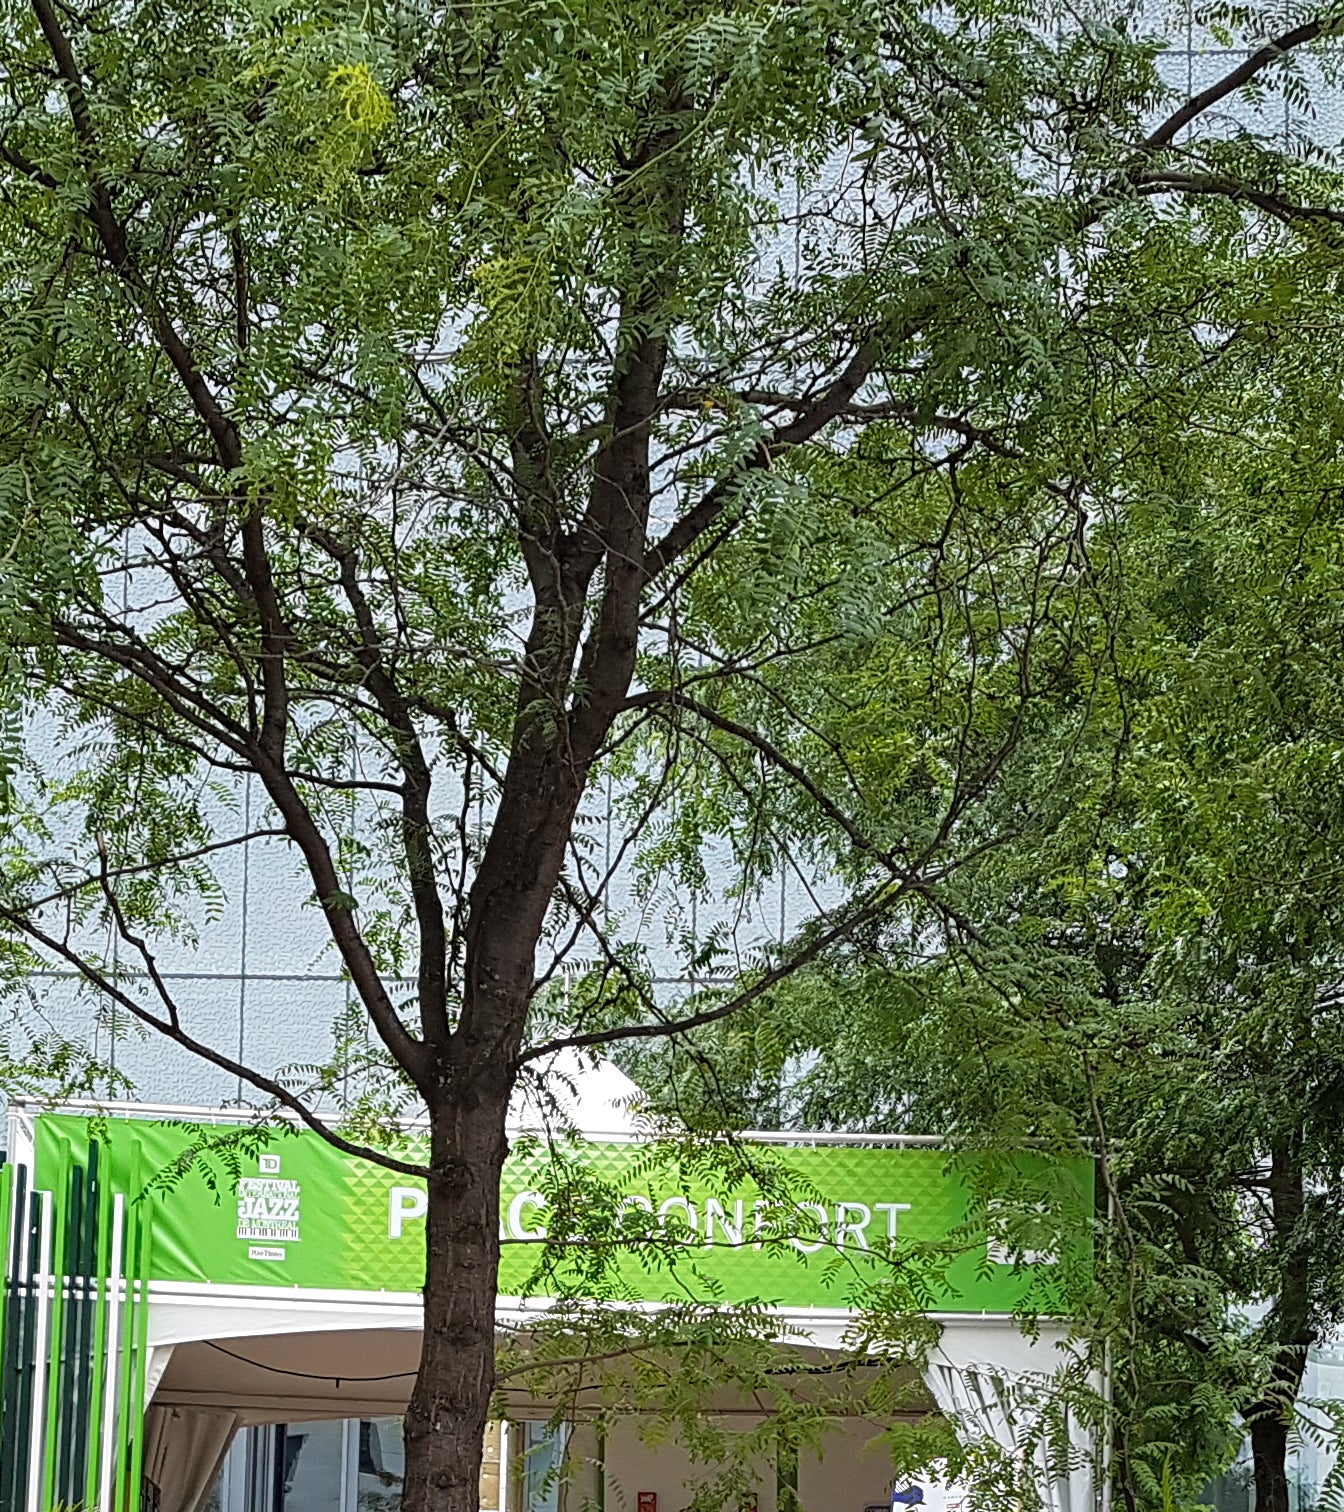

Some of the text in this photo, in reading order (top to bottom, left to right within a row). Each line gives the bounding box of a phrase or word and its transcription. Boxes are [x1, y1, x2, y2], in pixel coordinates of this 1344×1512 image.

[262, 1158, 278, 1169] TD
[239, 1178, 301, 1193] FESTIVAL
[237, 1197, 300, 1221] JAZZ
